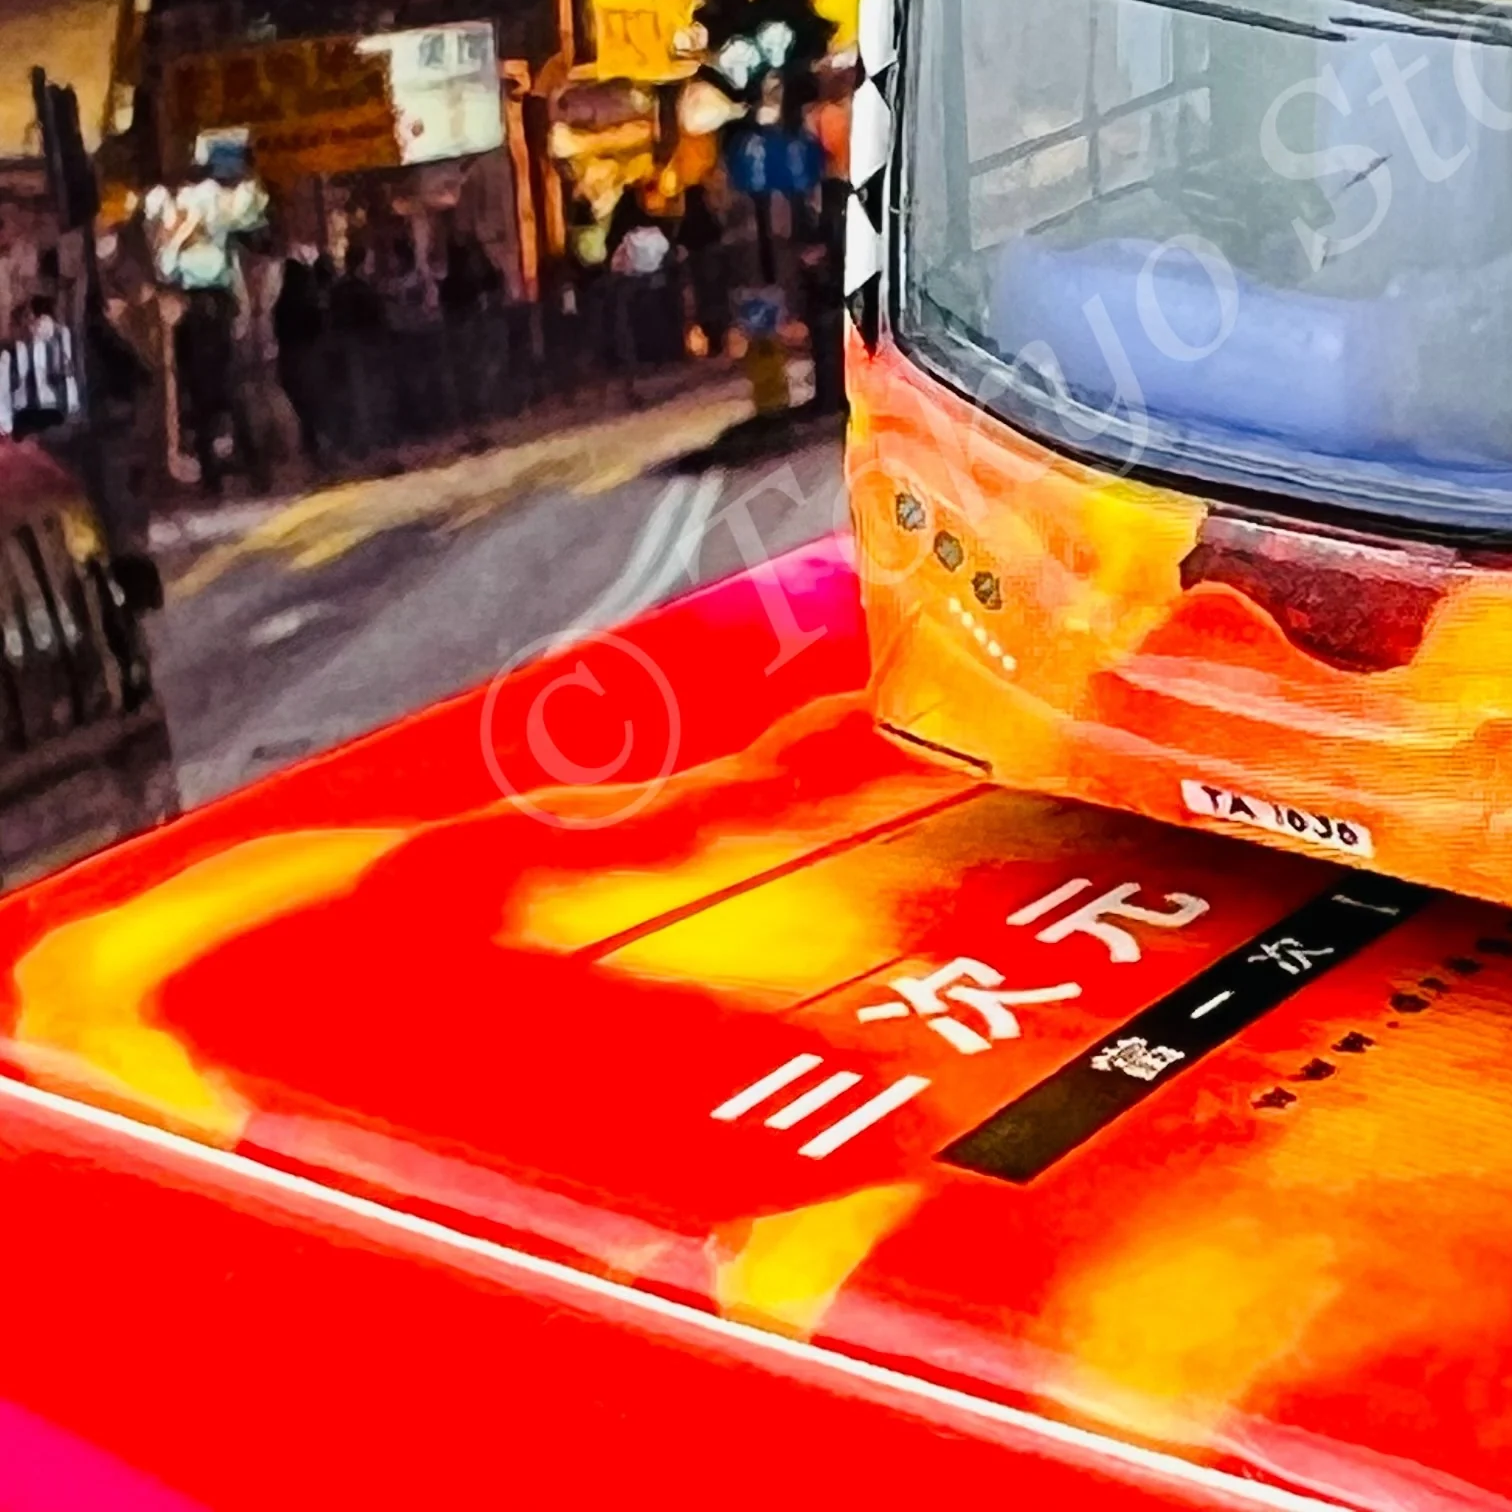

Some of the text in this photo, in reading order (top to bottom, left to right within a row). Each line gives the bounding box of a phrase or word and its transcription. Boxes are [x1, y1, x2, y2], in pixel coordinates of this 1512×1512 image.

[1200, 784, 1257, 820] TA
[711, 877, 1210, 1160] 三次元
